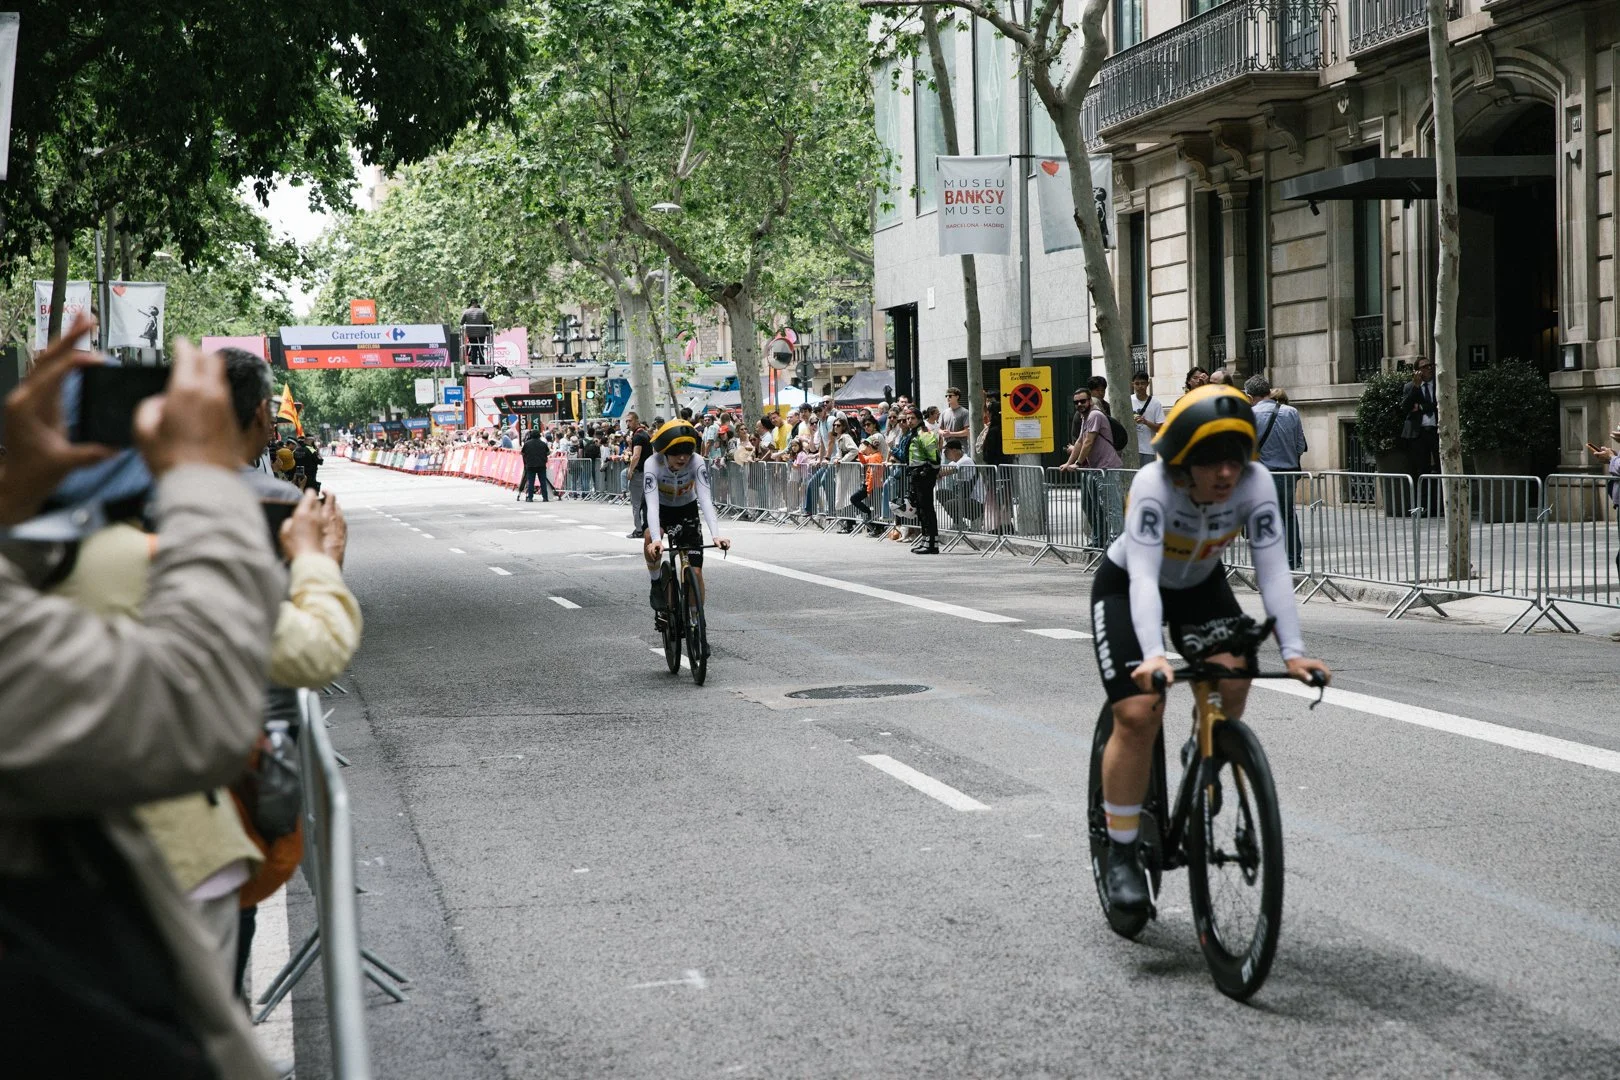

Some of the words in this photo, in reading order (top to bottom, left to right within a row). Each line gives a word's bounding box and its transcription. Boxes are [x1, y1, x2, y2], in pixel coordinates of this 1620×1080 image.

[944, 179, 1005, 188] MUSEU
[945, 190, 1005, 205] BANKSY
[945, 206, 1005, 215] MUSEO
[331, 330, 381, 340] Carrefour
[1140, 509, 1158, 538] R
[1256, 513, 1275, 541] R
